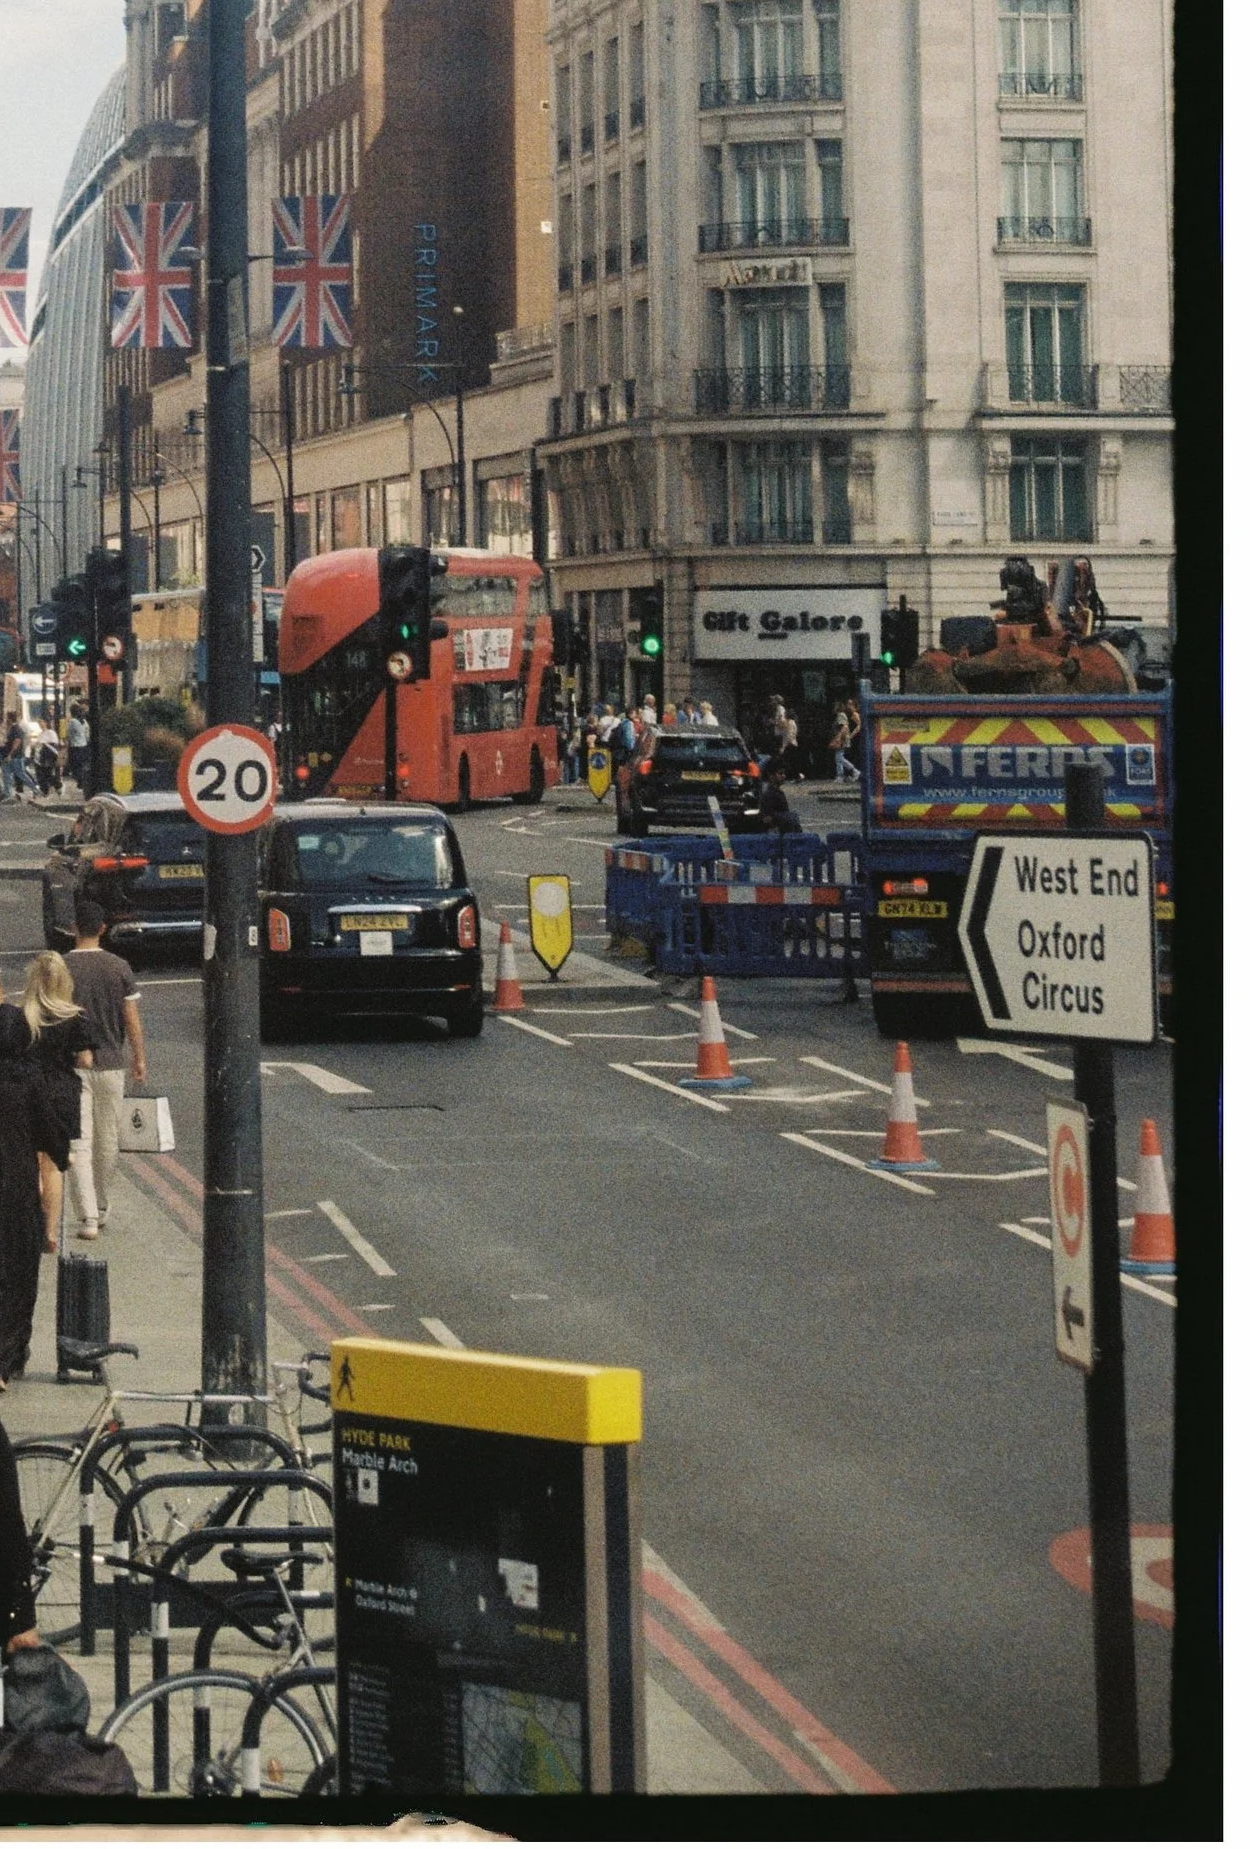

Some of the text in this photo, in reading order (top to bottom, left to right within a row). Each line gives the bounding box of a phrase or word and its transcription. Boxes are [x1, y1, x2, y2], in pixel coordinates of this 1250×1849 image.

[414, 222, 440, 384] PRIMARK
[703, 610, 863, 632] Gift Galore
[195, 758, 269, 802] 20
[1014, 855, 1139, 897] West End
[1017, 919, 1105, 962] Oxford
[1021, 970, 1104, 1015] Circus
[342, 1430, 411, 1451] HYDE PARK
[342, 1447, 419, 1475] Marble Arch
